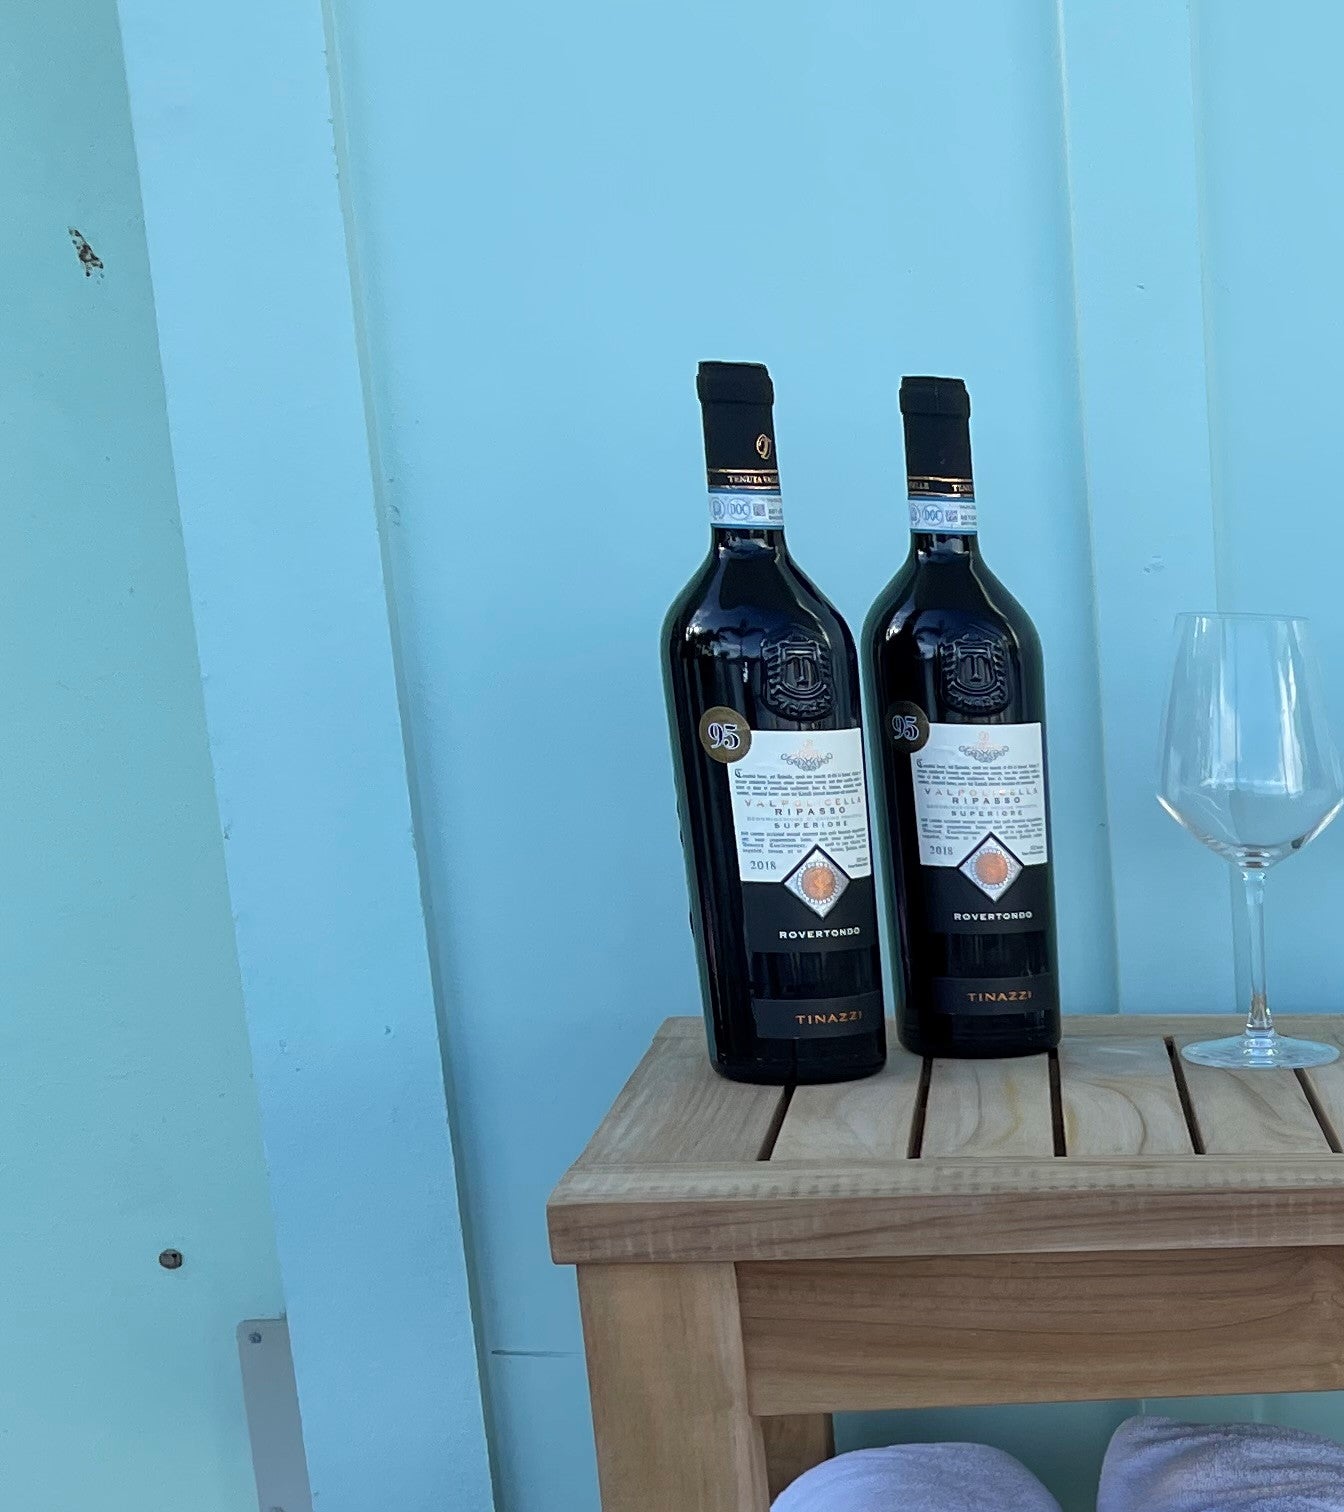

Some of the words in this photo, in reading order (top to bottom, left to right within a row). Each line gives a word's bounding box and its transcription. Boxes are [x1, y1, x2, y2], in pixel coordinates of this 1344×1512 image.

[891, 715, 920, 741] 95
[707, 722, 741, 750] 95
[744, 795, 862, 808] VALPOLCELLA
[952, 796, 1021, 805] RIPASSO
[775, 805, 847, 816] RIPASSO
[929, 845, 954, 856] 2018
[750, 860, 777, 871] 2018
[953, 911, 1033, 921] ROVERTONDO
[778, 926, 861, 939] ROVERTONDO
[968, 990, 1032, 1002] TINAZZI
[795, 1010, 863, 1025] TINAZZI
